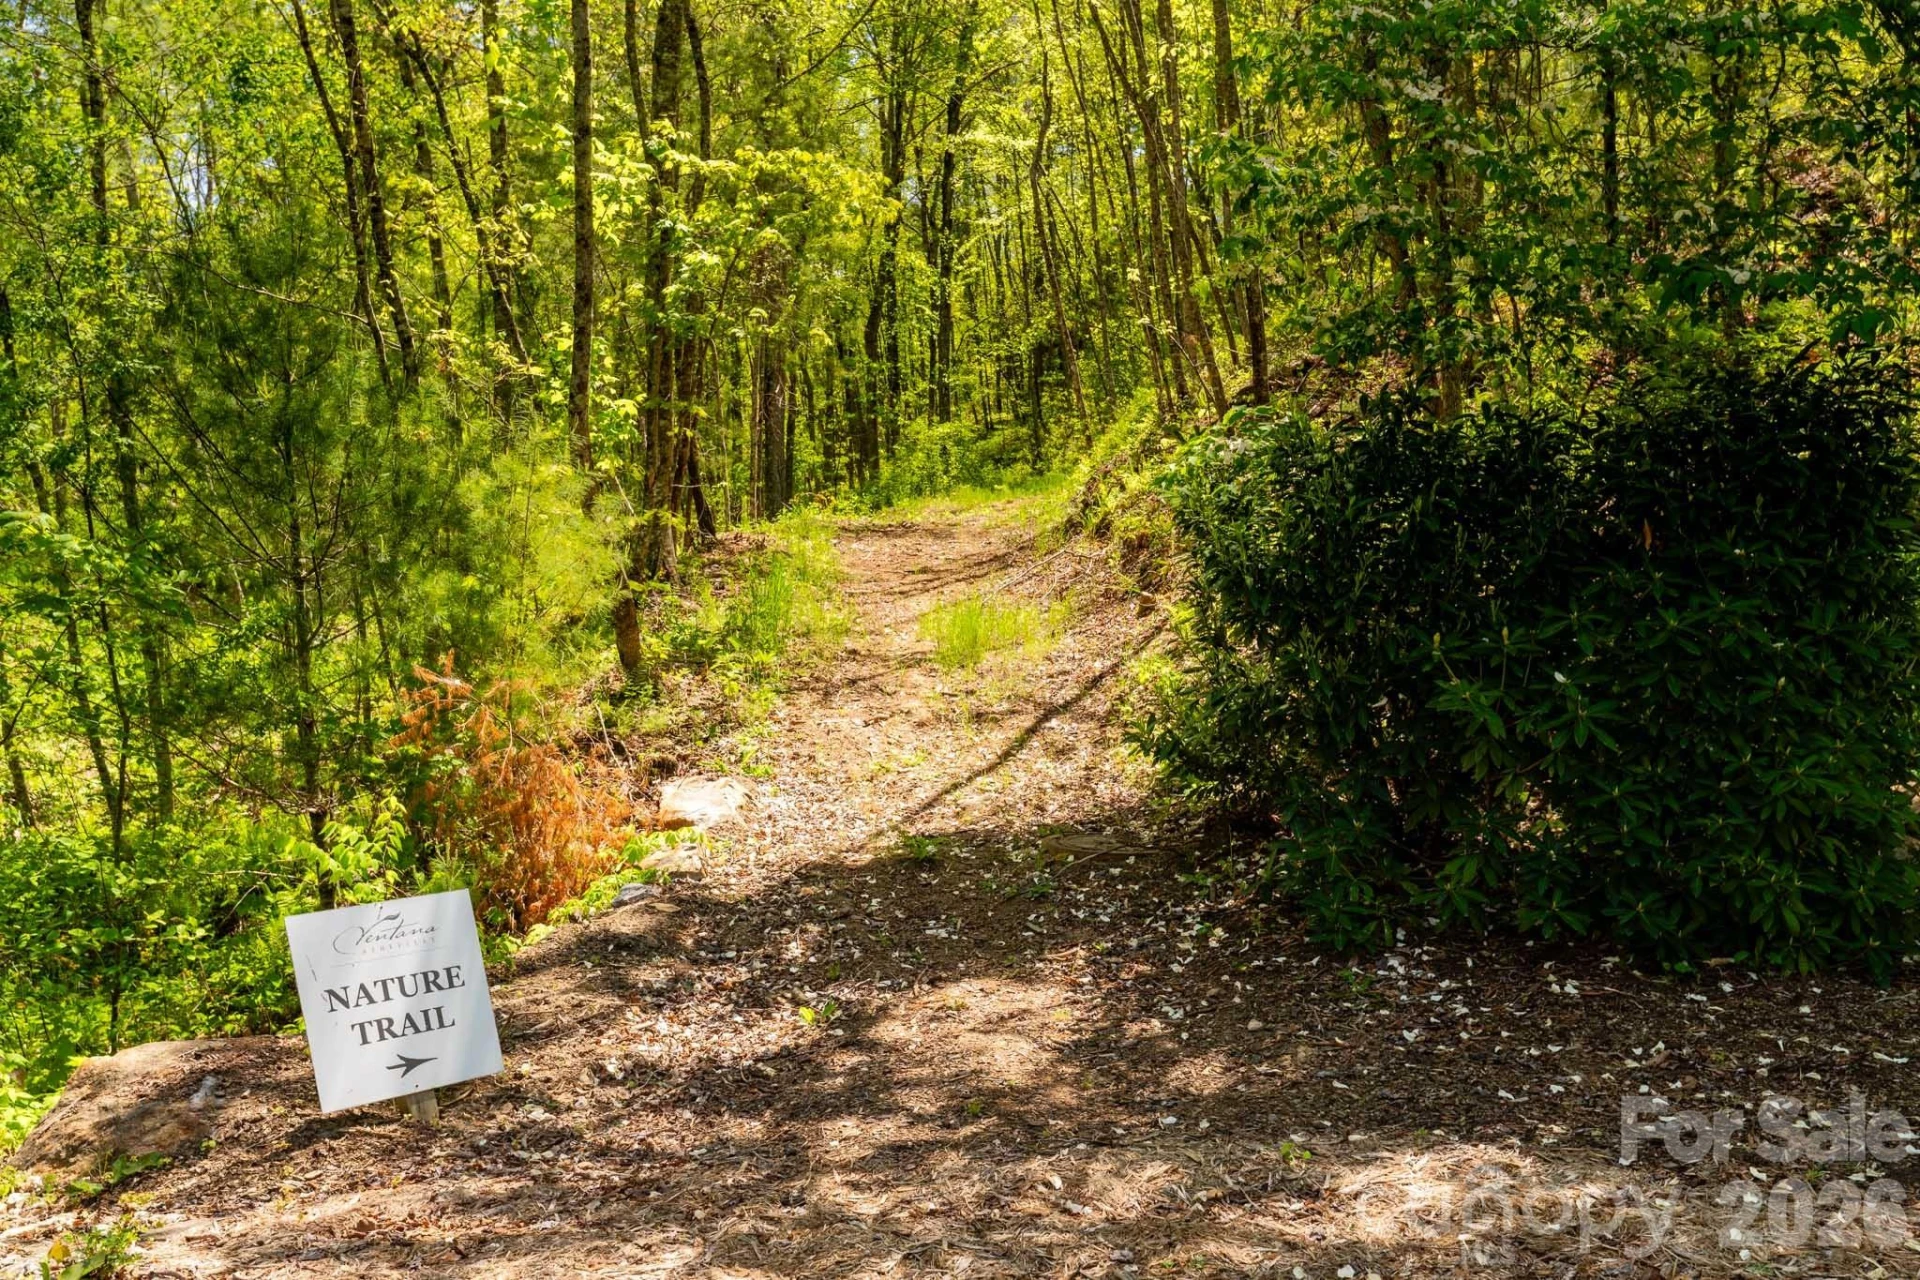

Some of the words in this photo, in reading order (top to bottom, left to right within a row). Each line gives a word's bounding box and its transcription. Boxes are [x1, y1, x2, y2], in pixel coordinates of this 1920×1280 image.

[332, 911, 440, 955] Ventana
[324, 965, 466, 1013] NATURE
[351, 1005, 456, 1046] TRAIL
